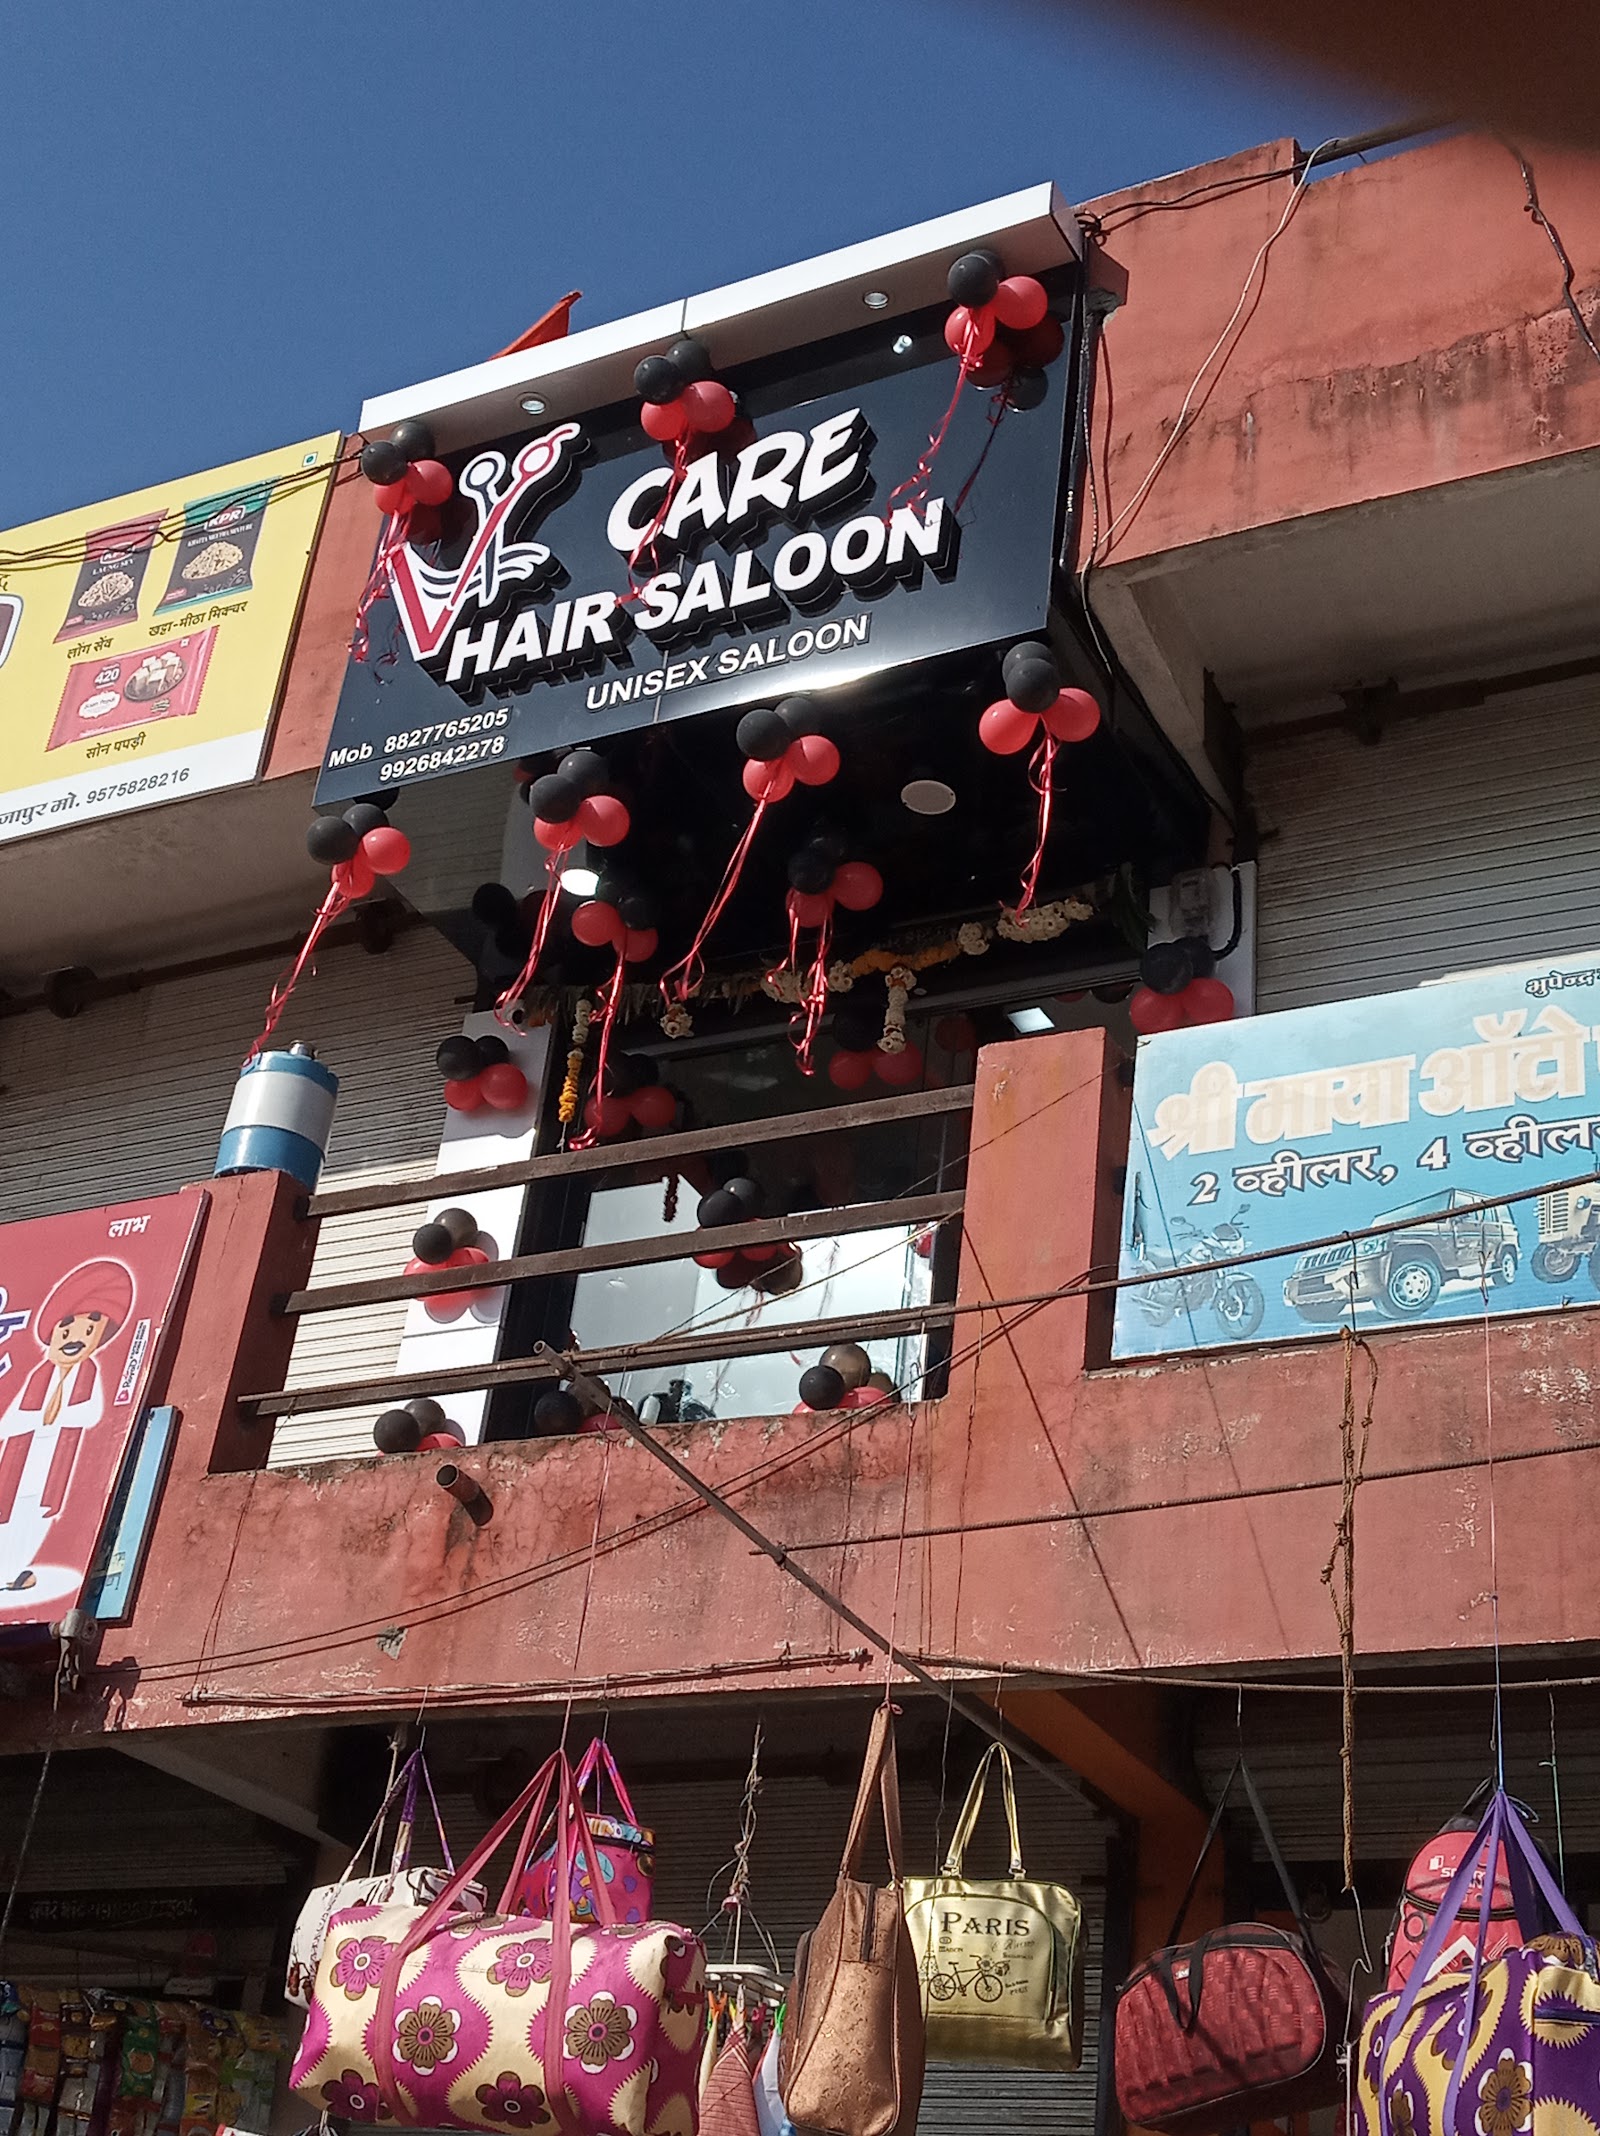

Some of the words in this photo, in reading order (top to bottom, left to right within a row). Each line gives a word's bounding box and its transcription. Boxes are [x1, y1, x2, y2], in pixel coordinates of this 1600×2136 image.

[606, 408, 860, 552] CARE
[445, 591, 618, 683] HAIR
[634, 497, 944, 631] SALOON
[95, 668, 120, 684] 420
[586, 656, 711, 710] UNISEX
[718, 615, 868, 675] SALOON
[86, 742, 111, 759] सोन
[114, 731, 146, 751] पपड़ी
[328, 742, 373, 768] Mob
[384, 707, 509, 754] 8827765205
[379, 735, 505, 781] 9926842278
[51, 792, 80, 813] मो.
[86, 768, 190, 804] 9575828216
[1525, 968, 1596, 998] भुपेन्द्र
[1146, 1060, 1243, 1161] श्री
[1243, 1054, 1416, 1145] माया
[1418, 1004, 1591, 1117] ऑटो
[1187, 1171, 1221, 1207] 2
[1416, 1136, 1451, 1171] 4
[1462, 1113, 1600, 1164] व्हील
[108, 1214, 152, 1238] लाभ
[940, 1911, 1030, 1937] PARIS
